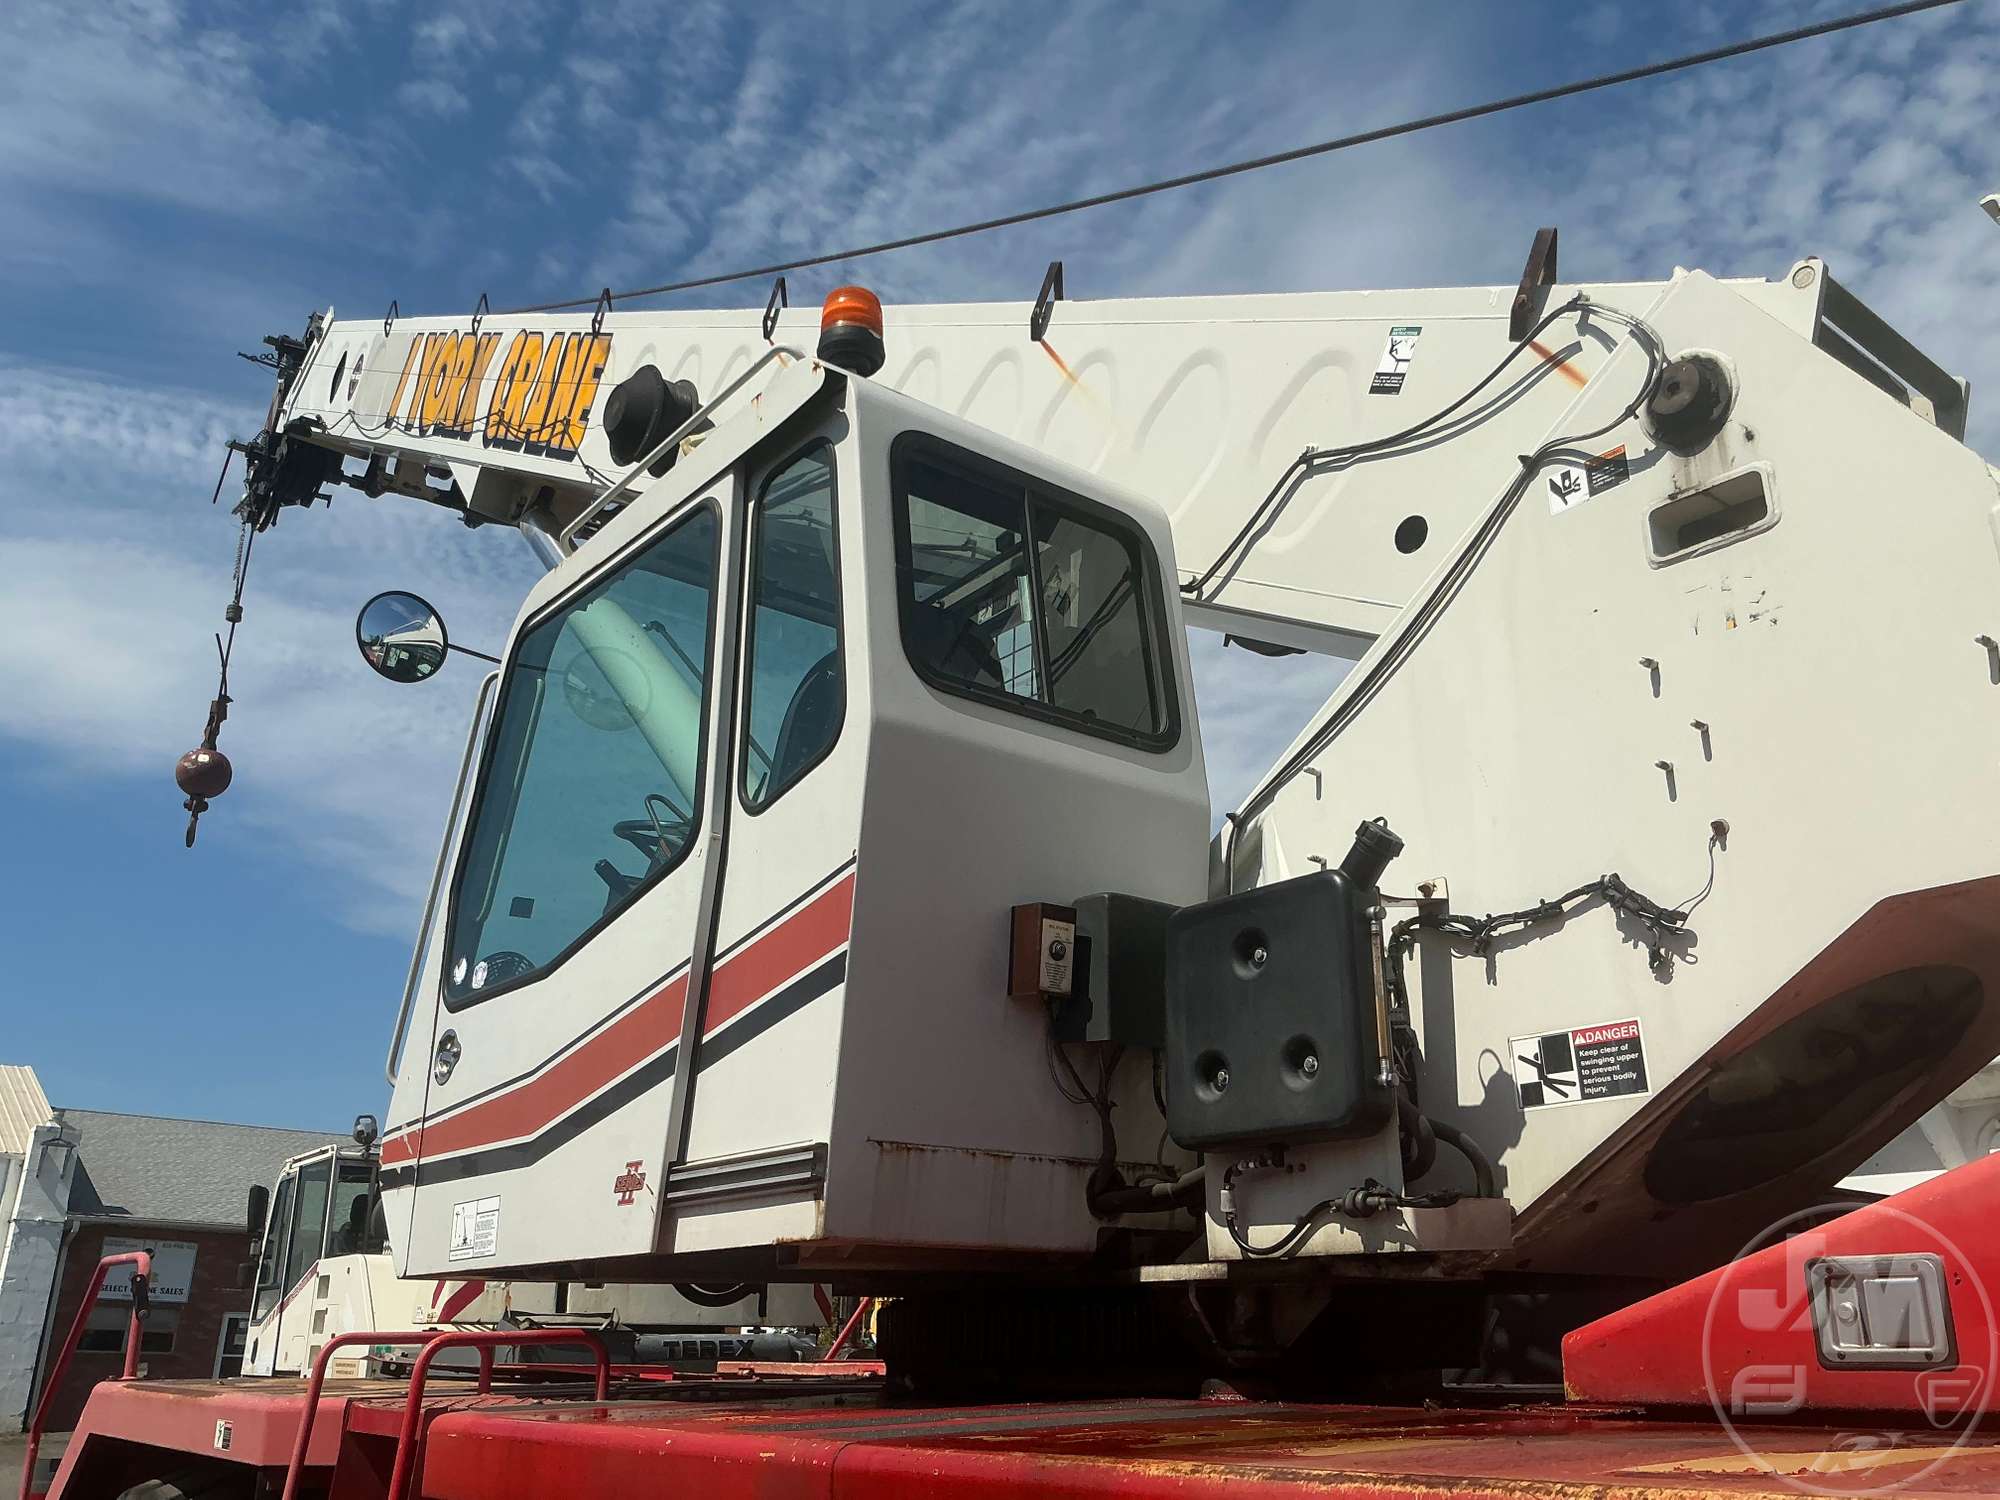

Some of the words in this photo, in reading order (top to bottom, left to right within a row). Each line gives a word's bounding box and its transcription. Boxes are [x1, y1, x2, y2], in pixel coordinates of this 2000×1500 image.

[404, 329, 503, 442] YORK
[483, 329, 614, 462] CRANE
[1585, 1025, 1638, 1043] DANGER
[1579, 1048, 1599, 1058] Keep
[1600, 1045, 1619, 1055] clear
[1620, 1043, 1629, 1052] of
[1580, 1056, 1615, 1067] swinging
[1616, 1052, 1639, 1062] upper
[1591, 1064, 1620, 1075] prevent
[1583, 1075, 1611, 1085] serious
[1612, 1072, 1637, 1083] bodily
[1584, 1084, 1608, 1095] injury.
[160, 1287, 184, 1296] SALES
[663, 1338, 755, 1360] TEREX
